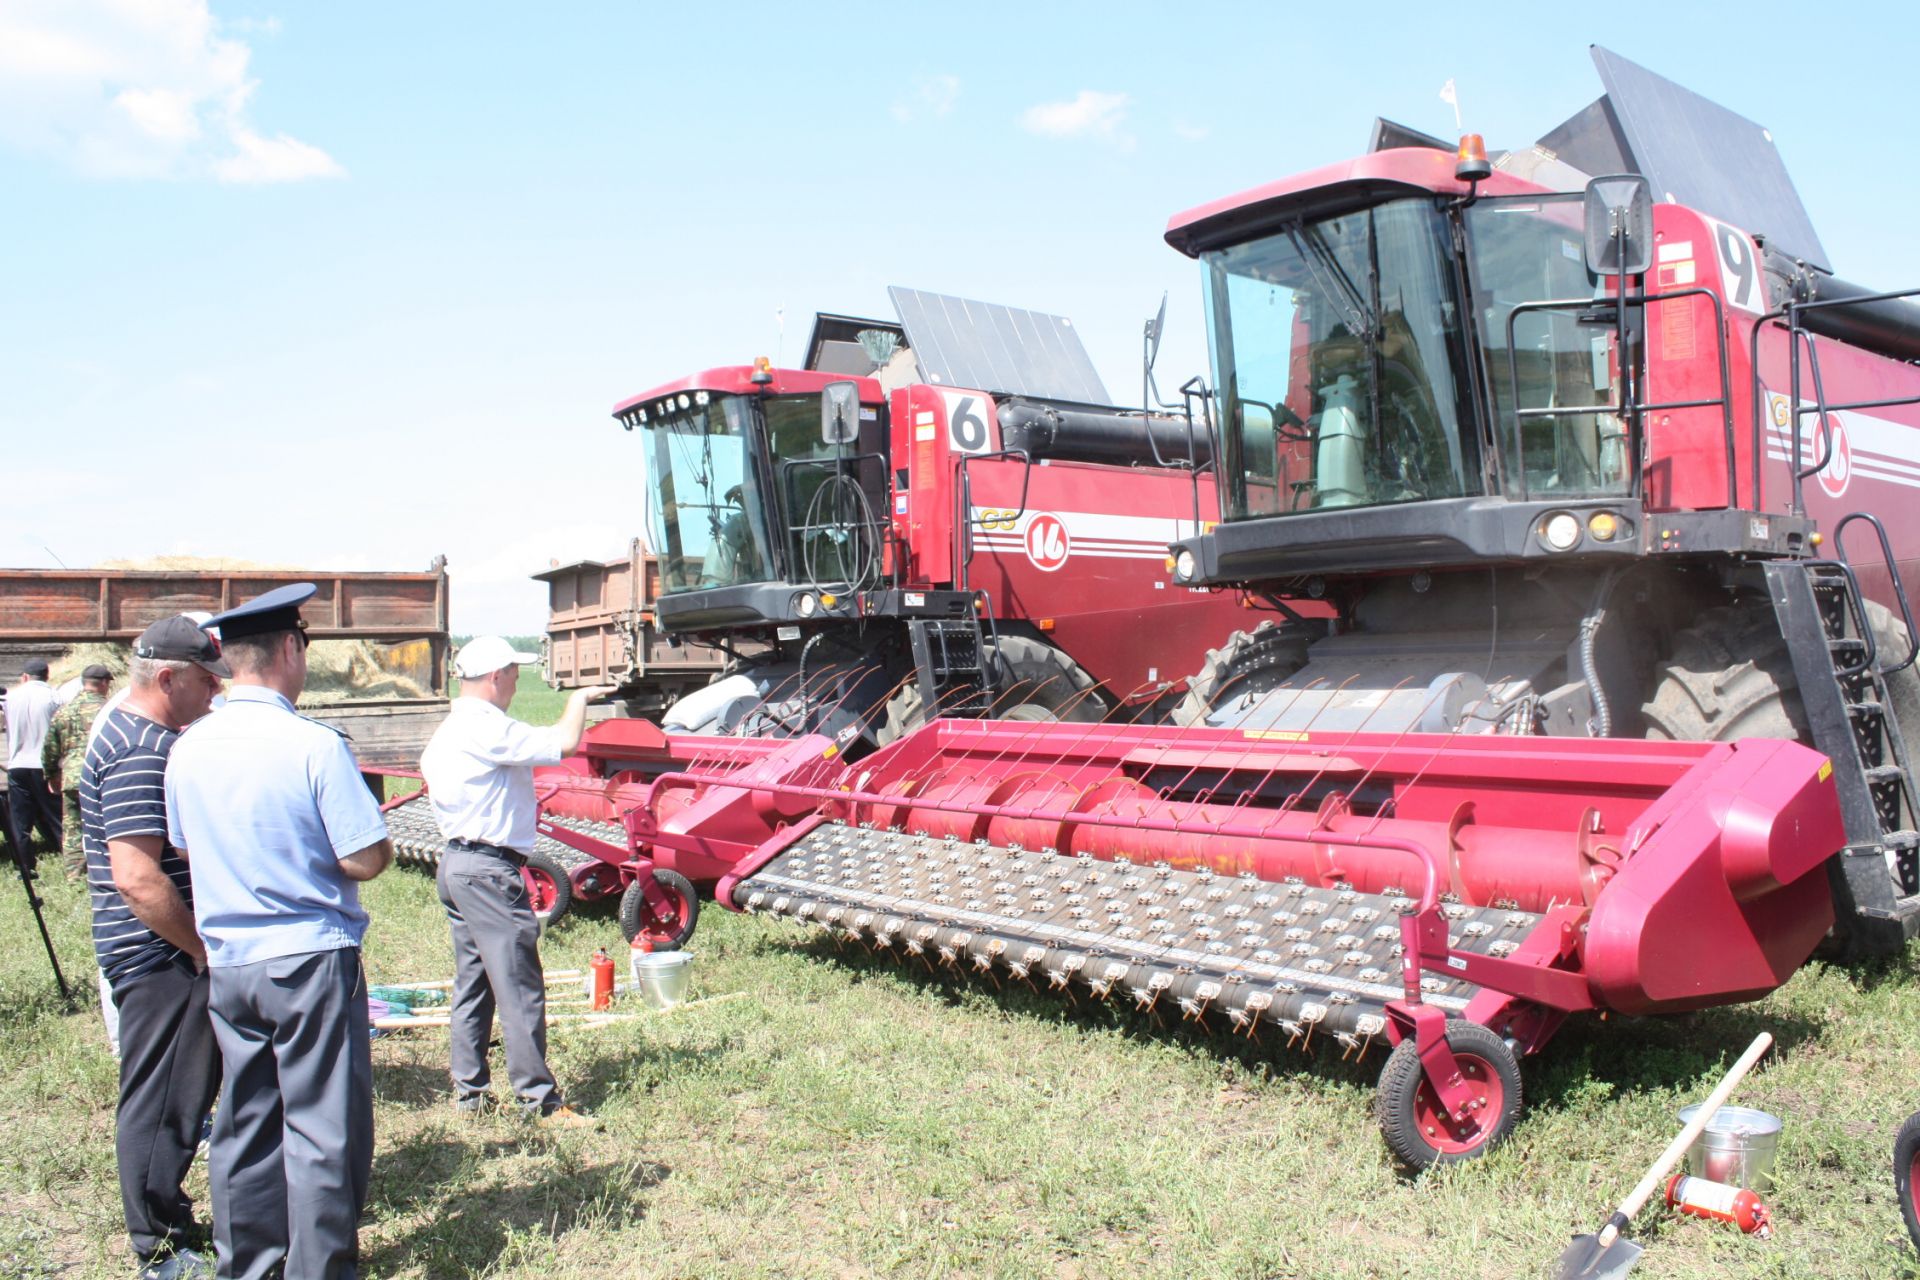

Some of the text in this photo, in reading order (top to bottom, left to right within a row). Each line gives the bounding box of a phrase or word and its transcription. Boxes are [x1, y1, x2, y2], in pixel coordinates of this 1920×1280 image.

[1716, 223, 1753, 306] 9
[951, 397, 986, 450] 6
[1032, 522, 1065, 560] 16
